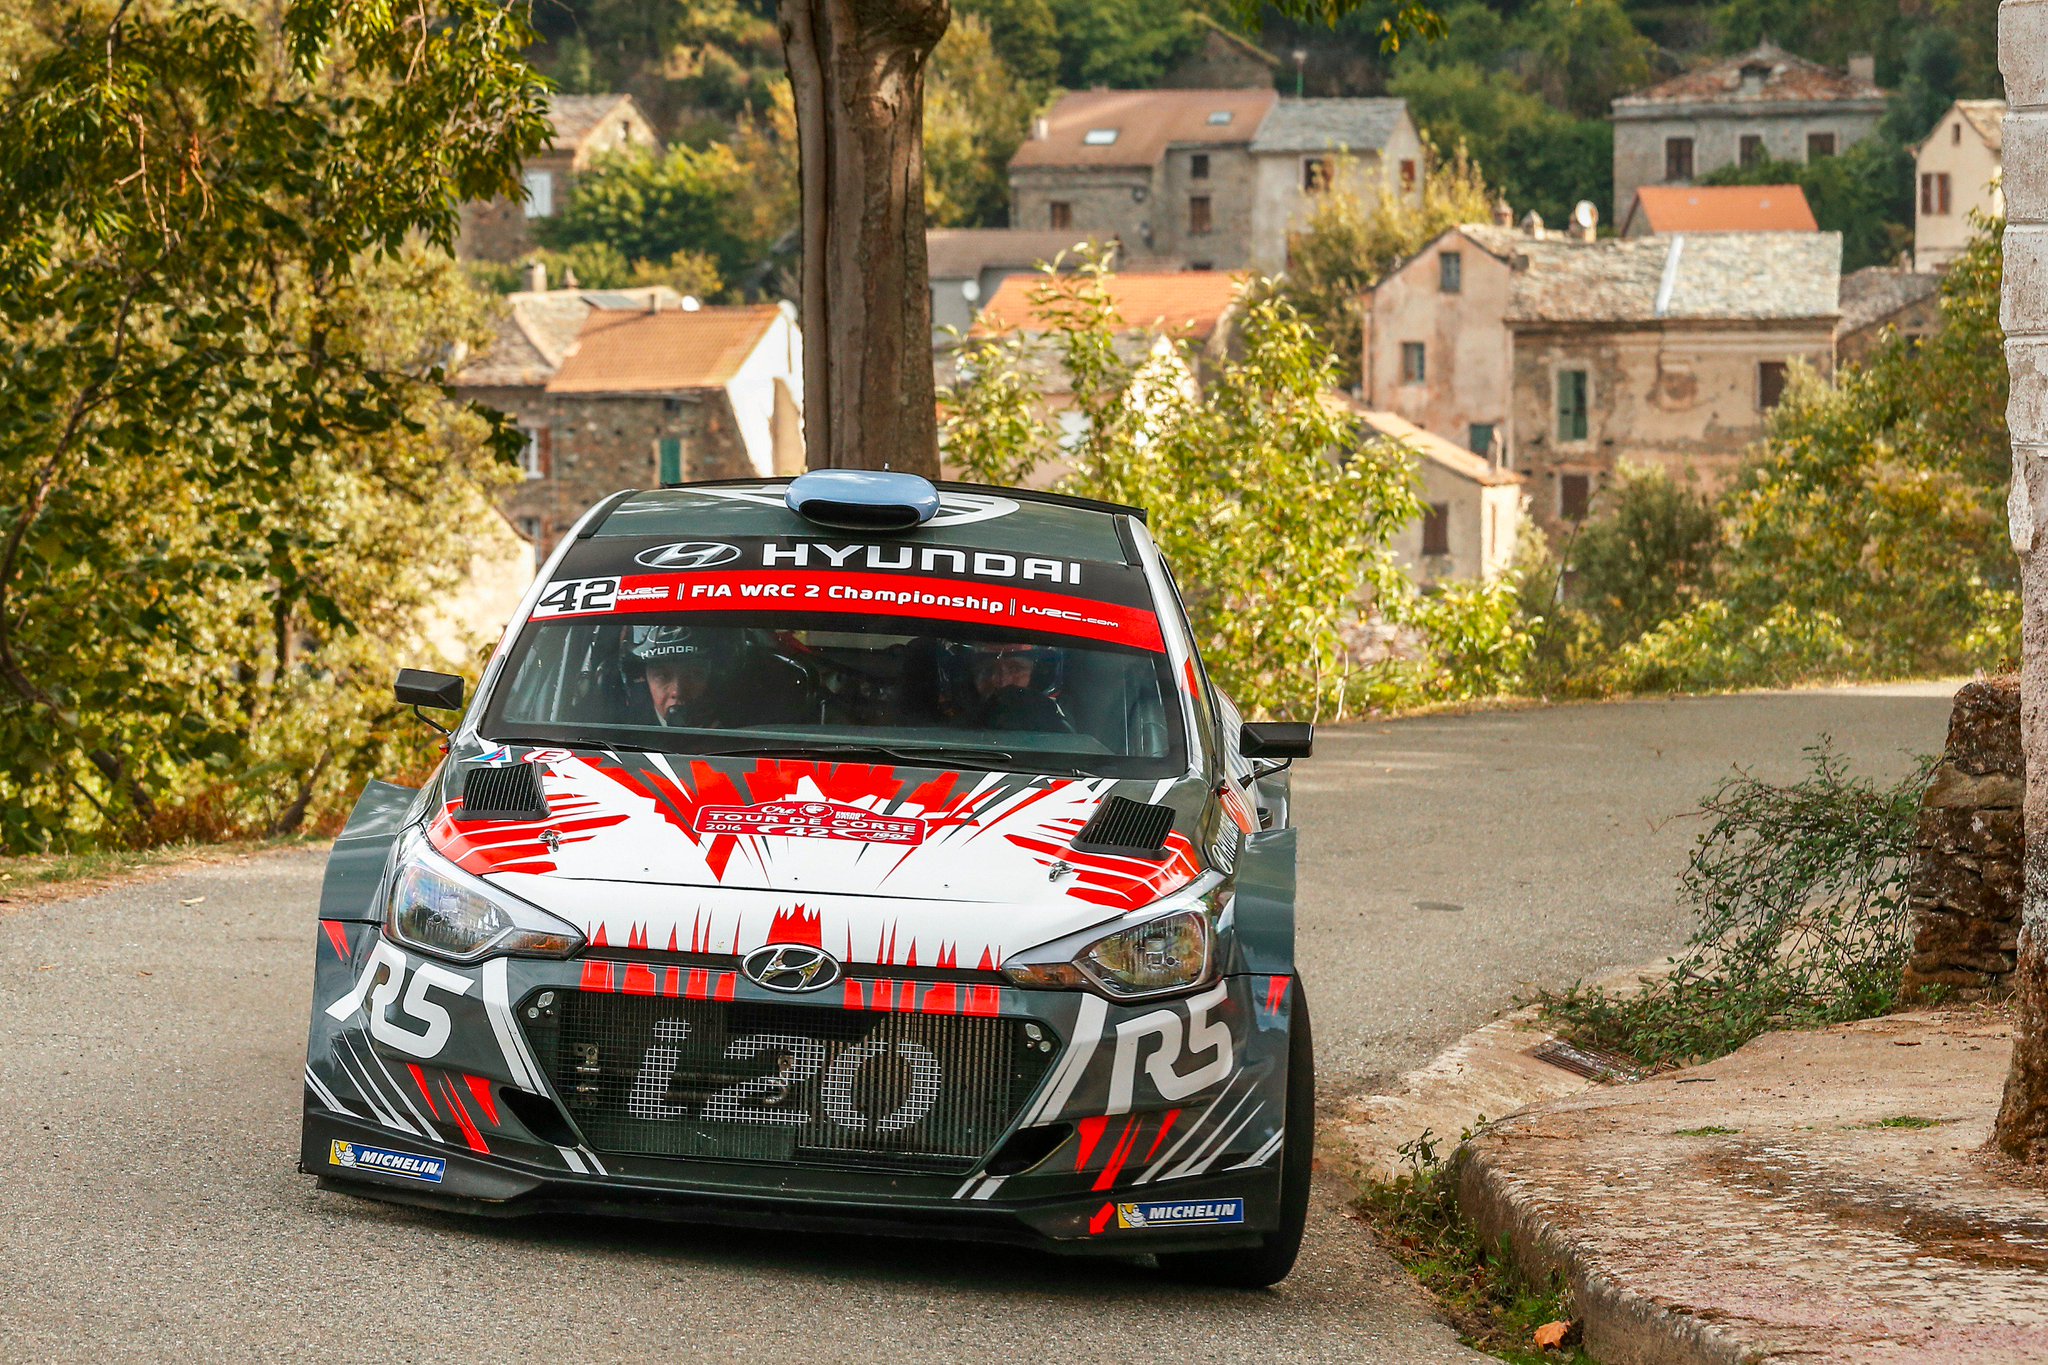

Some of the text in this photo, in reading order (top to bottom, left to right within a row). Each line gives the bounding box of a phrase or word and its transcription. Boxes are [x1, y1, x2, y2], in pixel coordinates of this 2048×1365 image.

[761, 543, 1082, 585] HYUNDAI
[539, 579, 617, 612] 42
[618, 586, 670, 597] WRC
[692, 583, 1004, 613] FIA WRC 2 Championship
[641, 645, 699, 660] HYUNDAI
[705, 823, 742, 832] 2016
[708, 812, 780, 823] TOUR
[788, 816, 822, 826] DE
[831, 819, 916, 833] CORSE
[784, 826, 829, 838] 42
[324, 939, 475, 1059] R5
[1105, 979, 1234, 1116] R5
[359, 1150, 440, 1176] MICHELIN
[1149, 1203, 1237, 1220] MICHELIN
